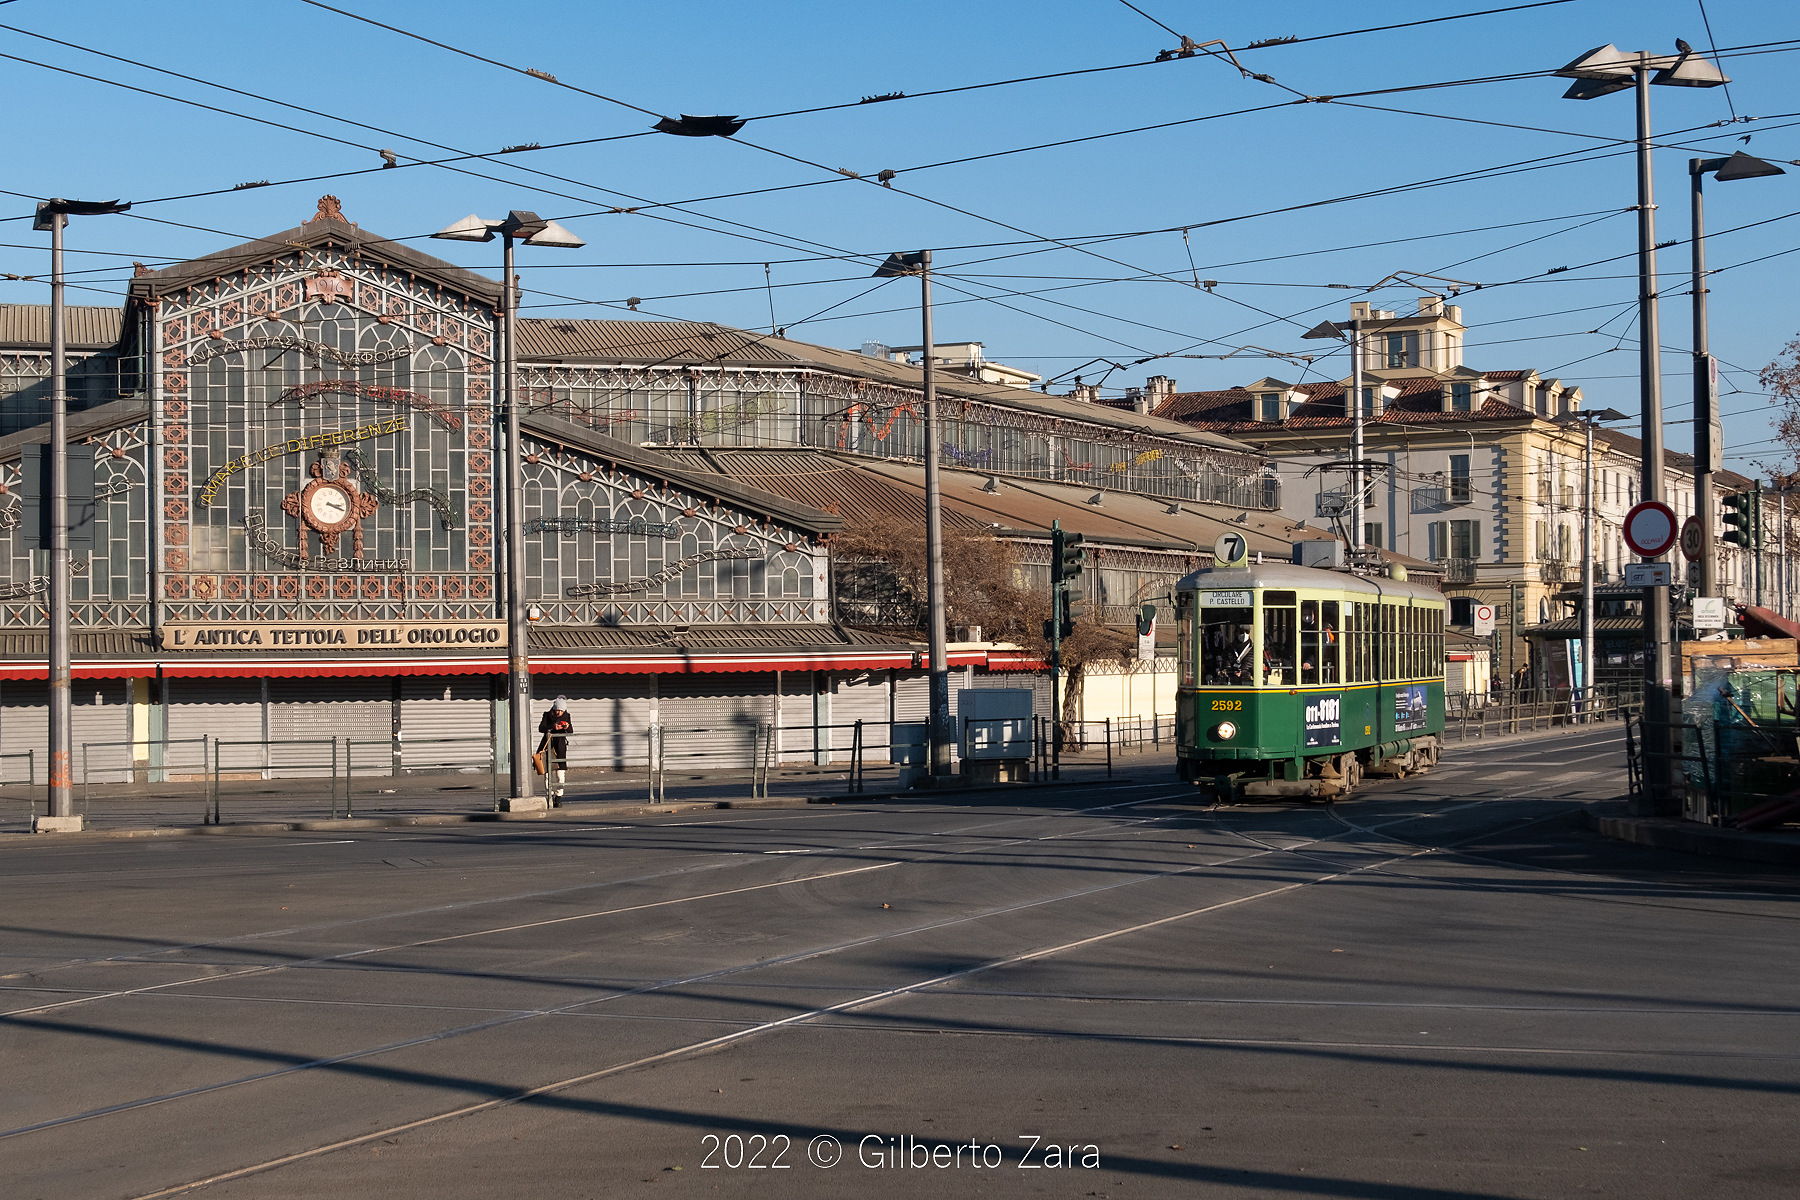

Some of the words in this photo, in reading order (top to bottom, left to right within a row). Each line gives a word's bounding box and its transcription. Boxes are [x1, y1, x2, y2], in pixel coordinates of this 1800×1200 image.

[314, 279, 344, 293] 1916
[200, 454, 254, 505] AMARE
[256, 446, 282, 462] LE
[286, 417, 406, 452] DIFFERENZE
[1686, 528, 1700, 549] 30
[1224, 538, 1239, 561] 7
[269, 629, 348, 645] TETTOIA
[1211, 700, 1242, 711] 2592
